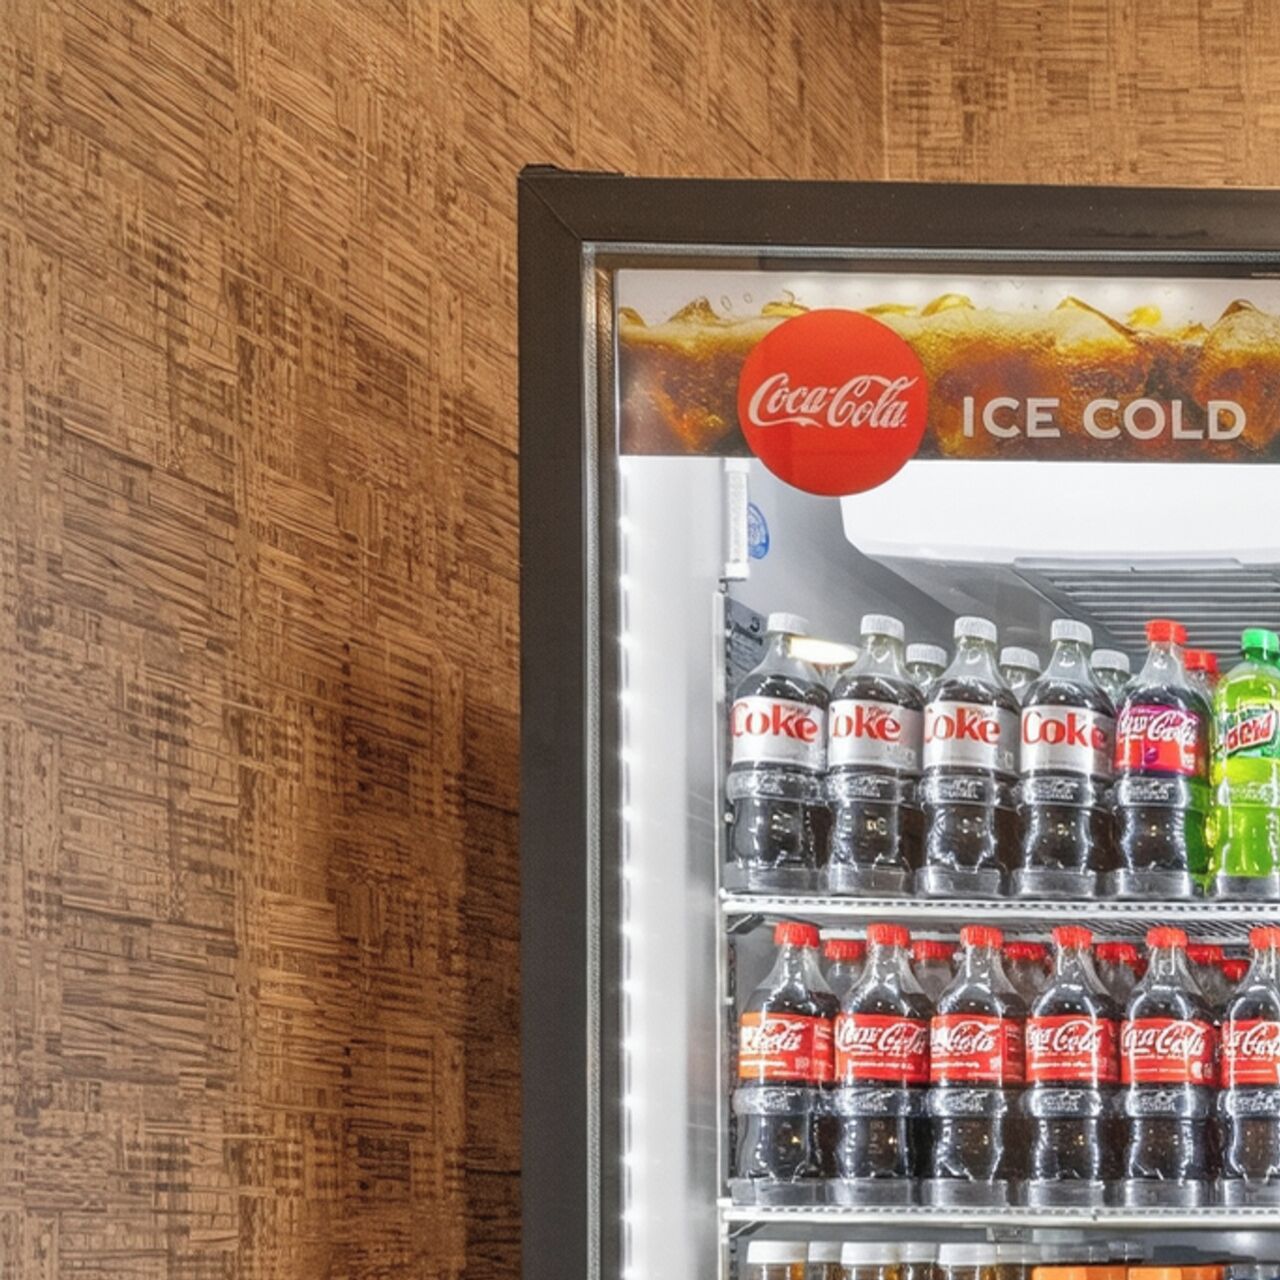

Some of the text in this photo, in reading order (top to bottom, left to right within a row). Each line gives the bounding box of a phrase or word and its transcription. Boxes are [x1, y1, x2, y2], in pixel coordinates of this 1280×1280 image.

[747, 372, 918, 430] Coca-Cola
[963, 397, 1246, 442] ICE COLD
[730, 703, 818, 743] Coke
[832, 703, 902, 743] oke
[1022, 709, 1109, 750] Coke
